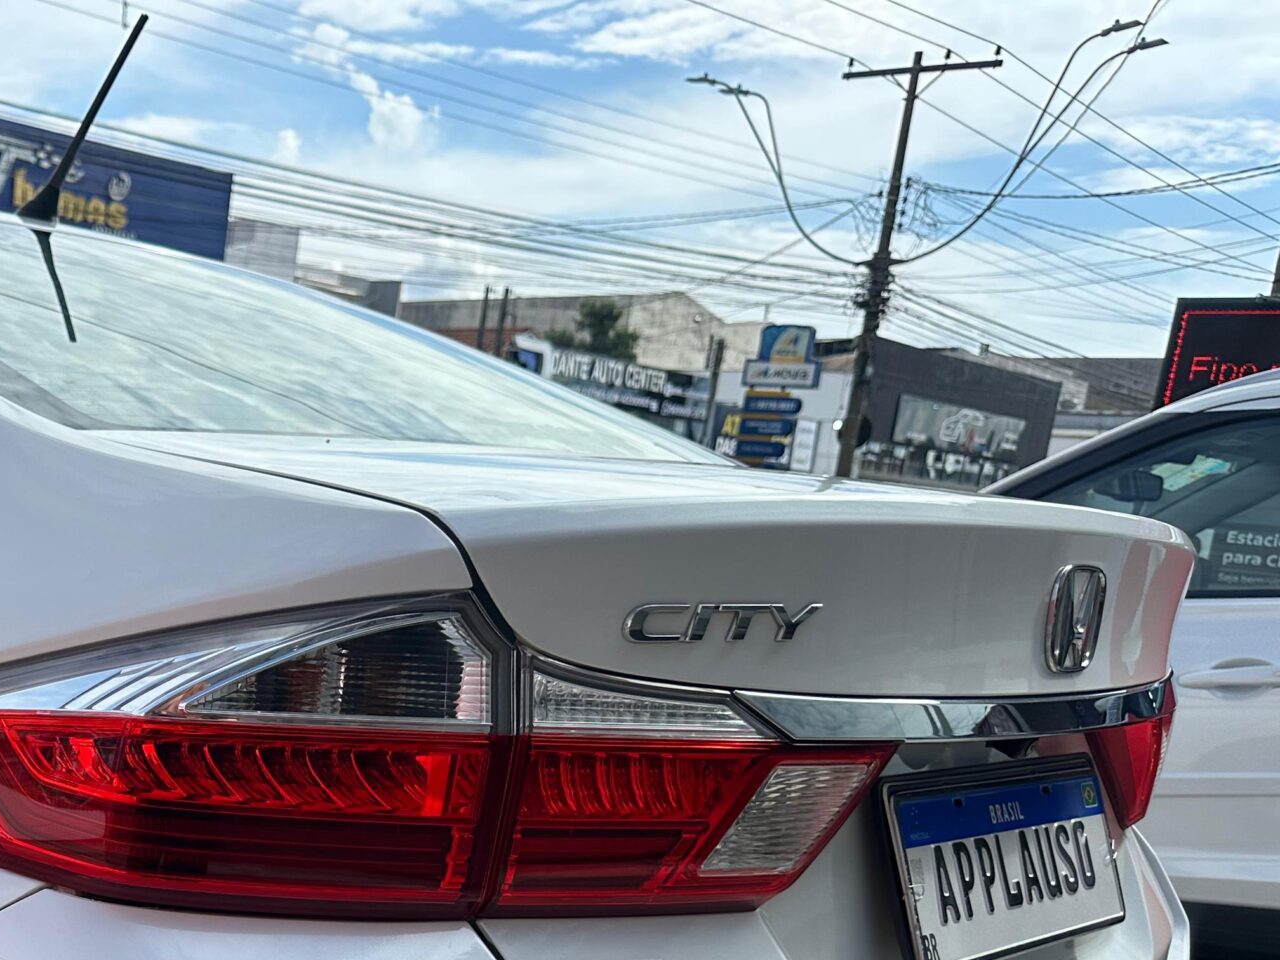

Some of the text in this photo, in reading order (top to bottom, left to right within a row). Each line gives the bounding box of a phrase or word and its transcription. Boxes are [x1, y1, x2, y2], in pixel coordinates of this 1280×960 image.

[591, 357, 623, 387] AUTO
[625, 362, 667, 394] CENTER
[1226, 530, 1280, 548] Estaci
[1222, 551, 1262, 567] para
[622, 602, 824, 643] CITY
[988, 801, 1024, 825] BRASIL
[931, 818, 1097, 927] APPLAUSO
